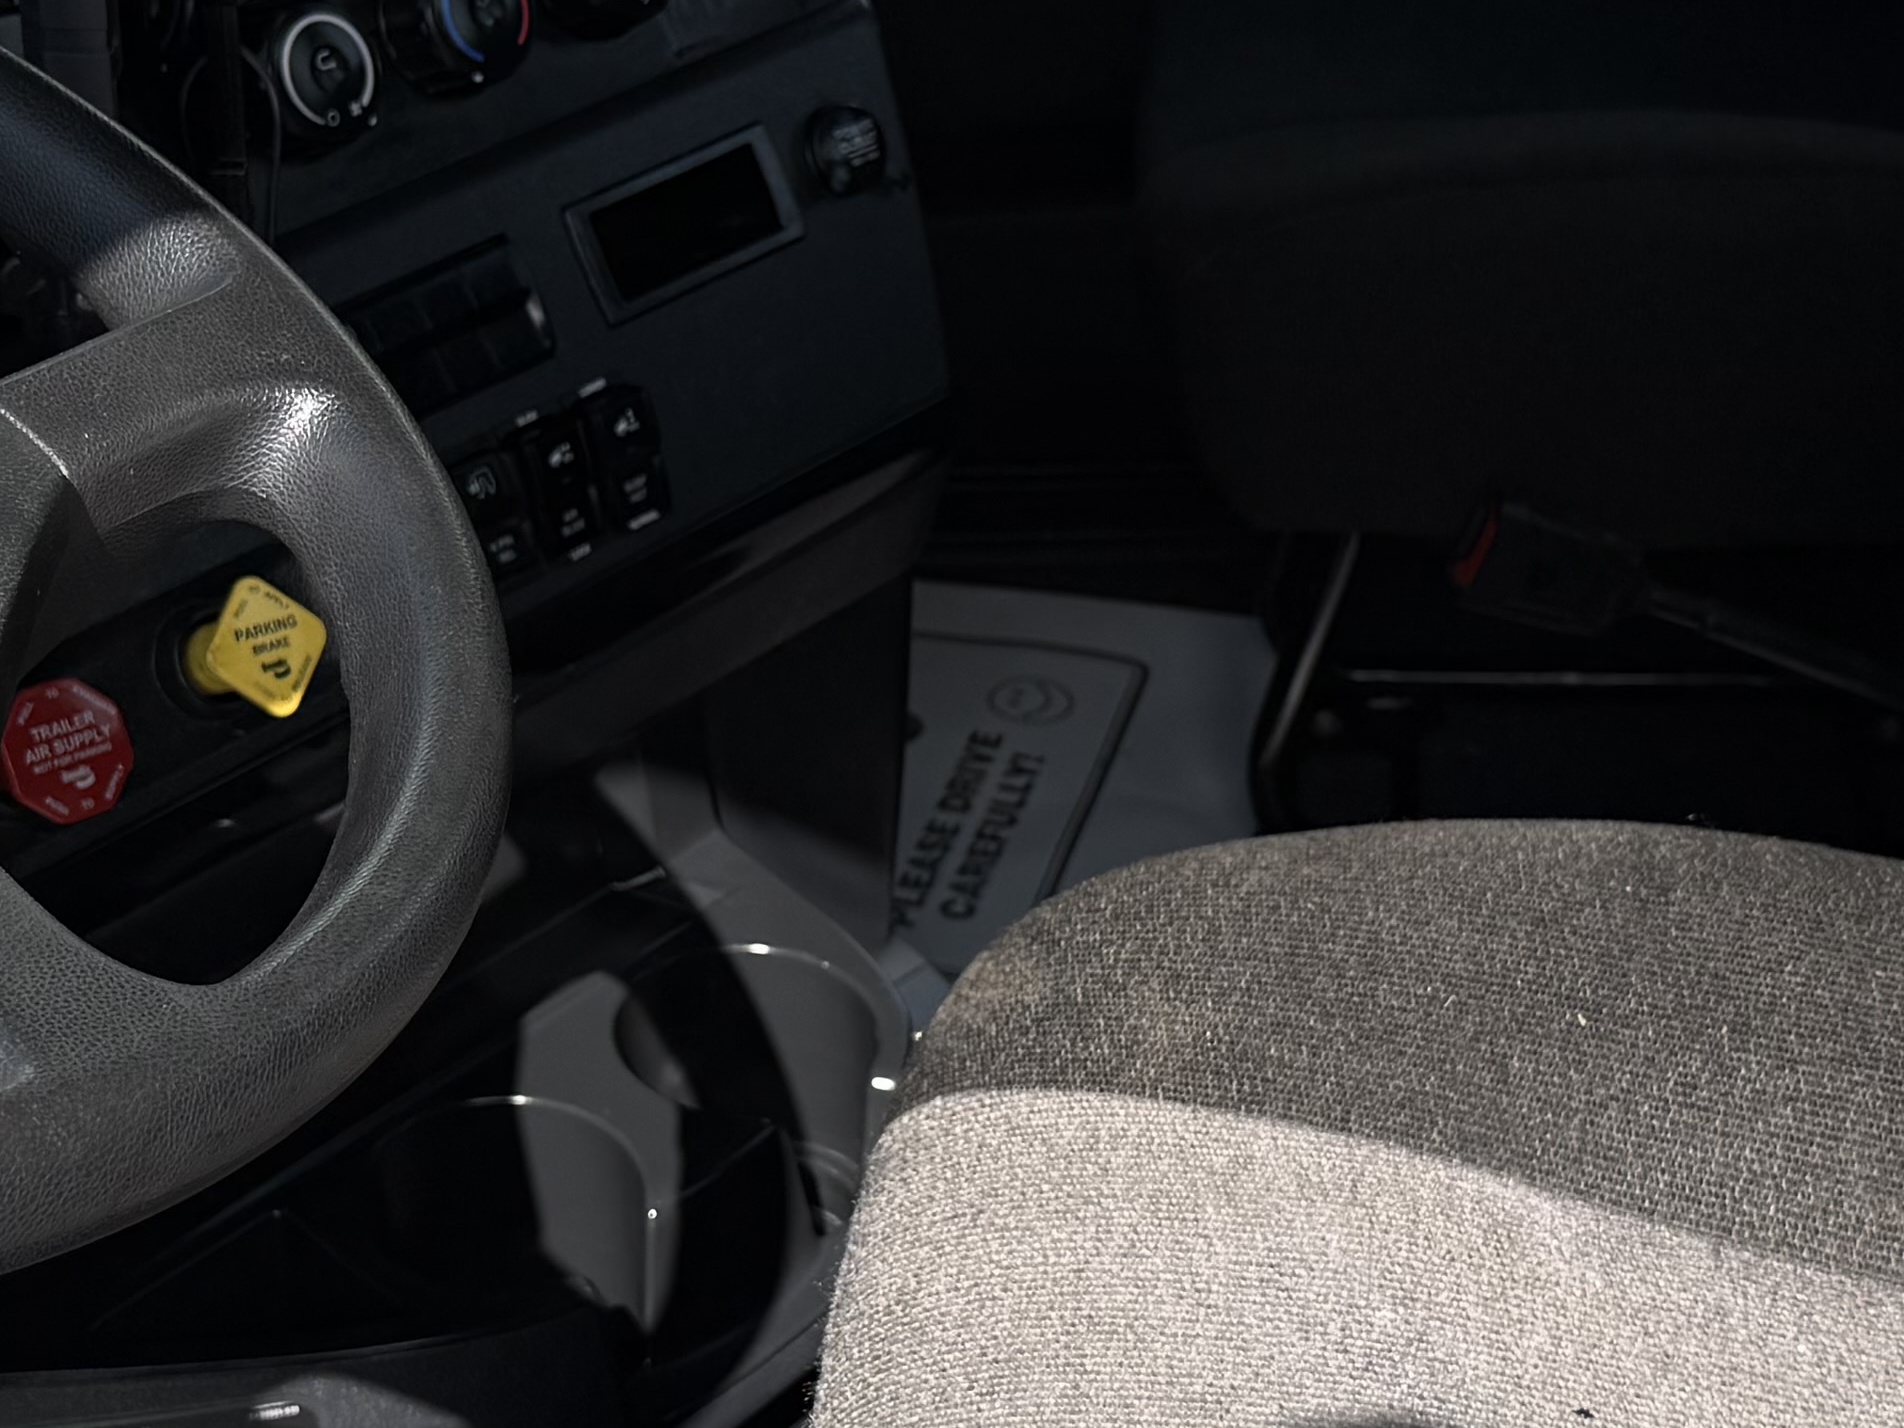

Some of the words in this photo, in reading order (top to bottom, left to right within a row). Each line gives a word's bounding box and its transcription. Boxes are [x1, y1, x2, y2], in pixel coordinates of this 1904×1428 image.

[234, 614, 298, 642] PARKING
[253, 635, 290, 655] BRAKE
[29, 710, 95, 743] TRAILER
[25, 743, 52, 766] AIR
[52, 723, 110, 755] SUPPLY
[938, 729, 1002, 813] DRIVE
